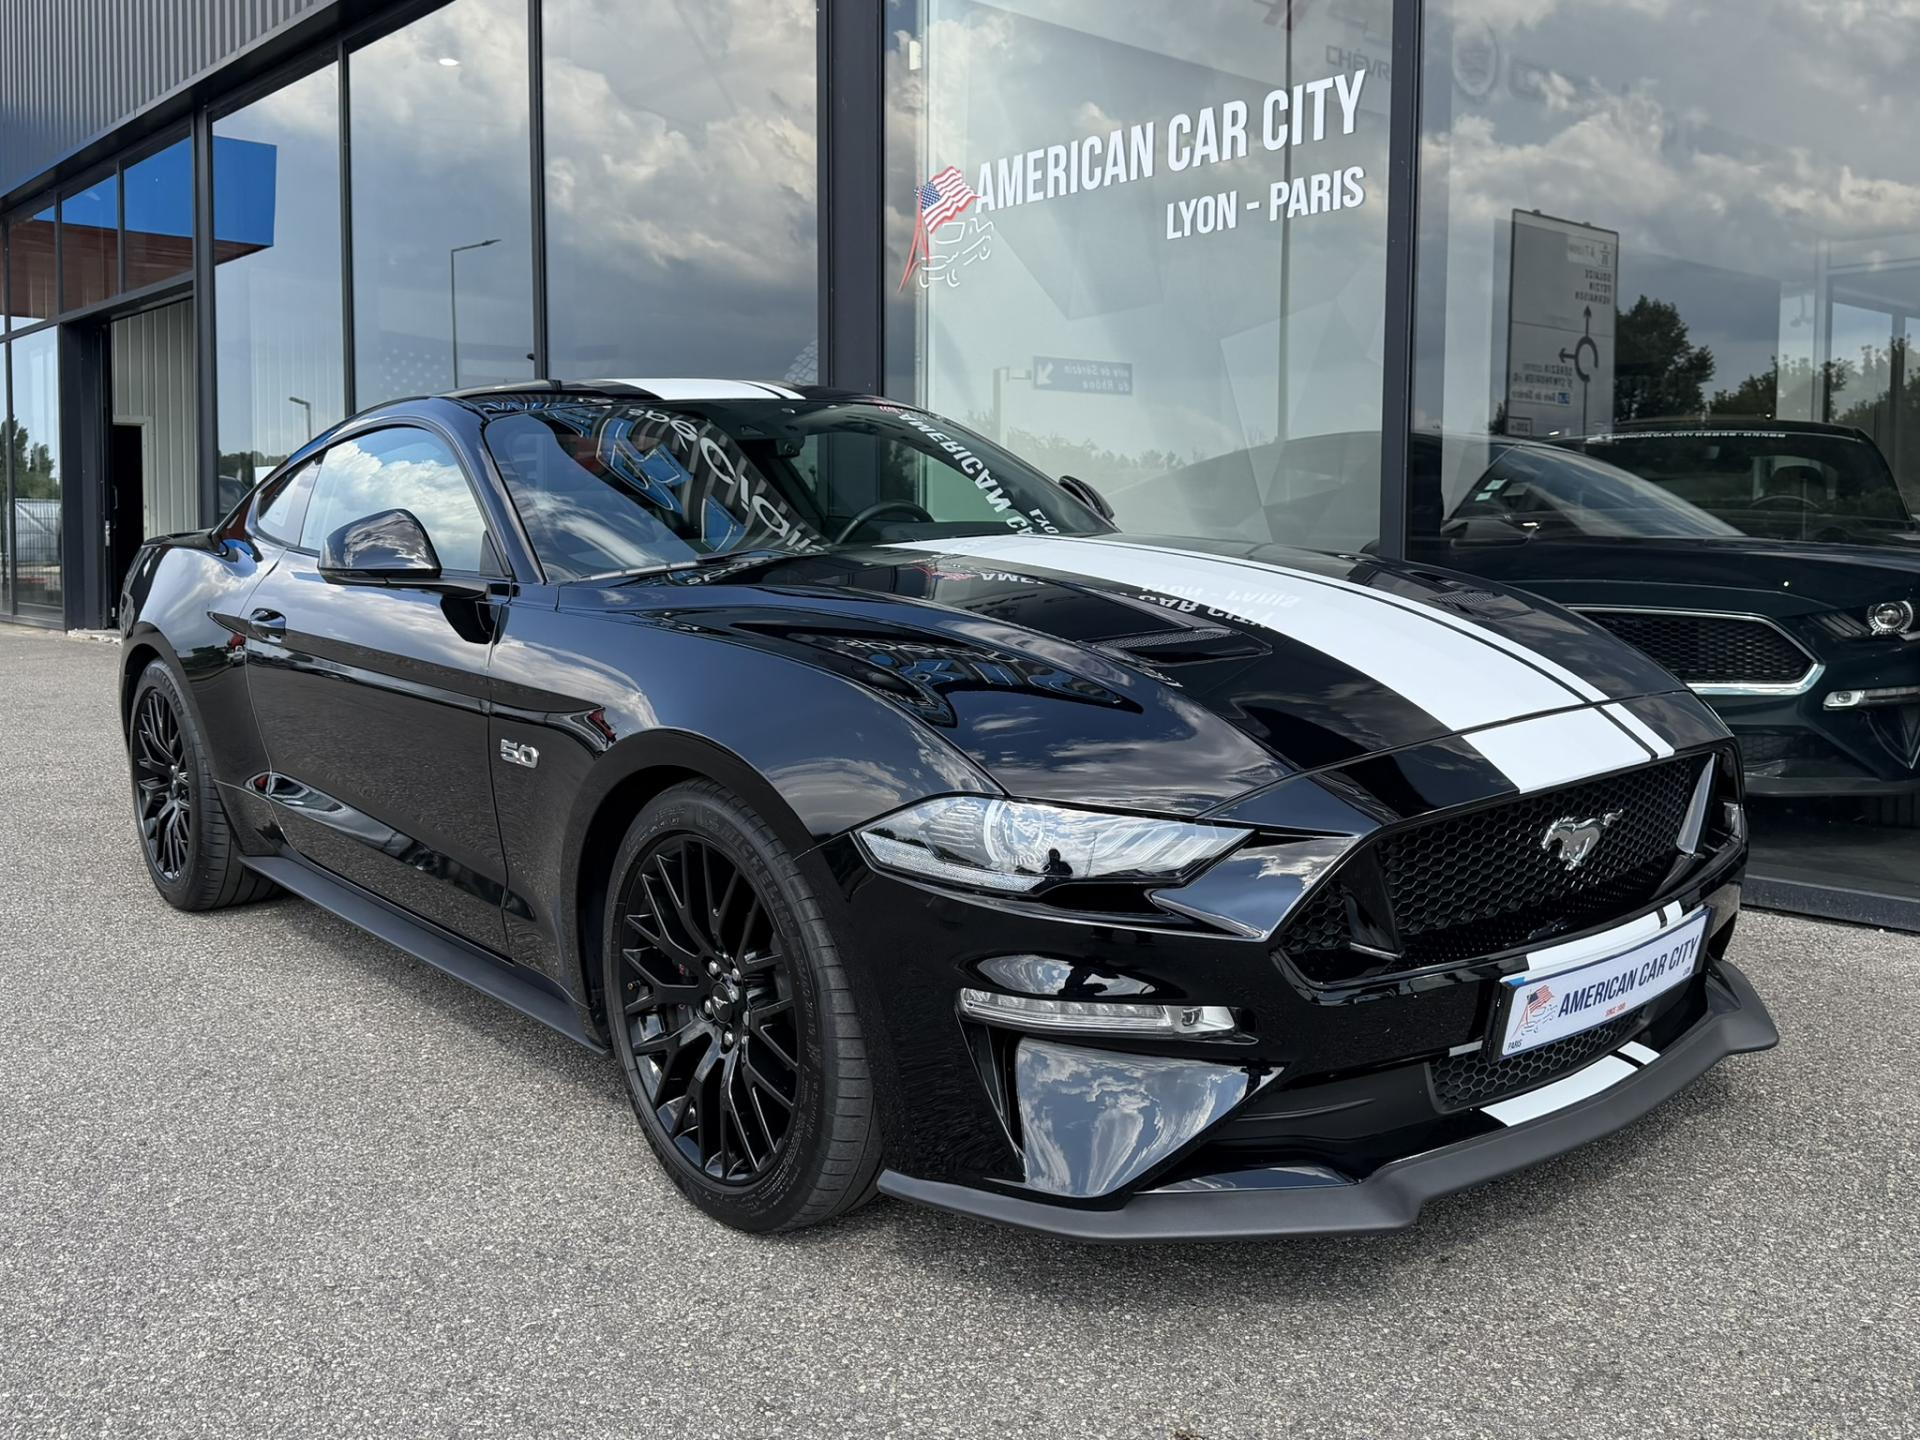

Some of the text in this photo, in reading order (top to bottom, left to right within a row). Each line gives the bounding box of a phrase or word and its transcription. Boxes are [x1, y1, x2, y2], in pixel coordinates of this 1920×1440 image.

[975, 68, 1366, 214] AMERICAN CAR CITY
[1166, 190, 1238, 240] LYON
[1269, 165, 1365, 222] PARIS
[1557, 934, 1700, 1018] AMERICAN CAR CITY
